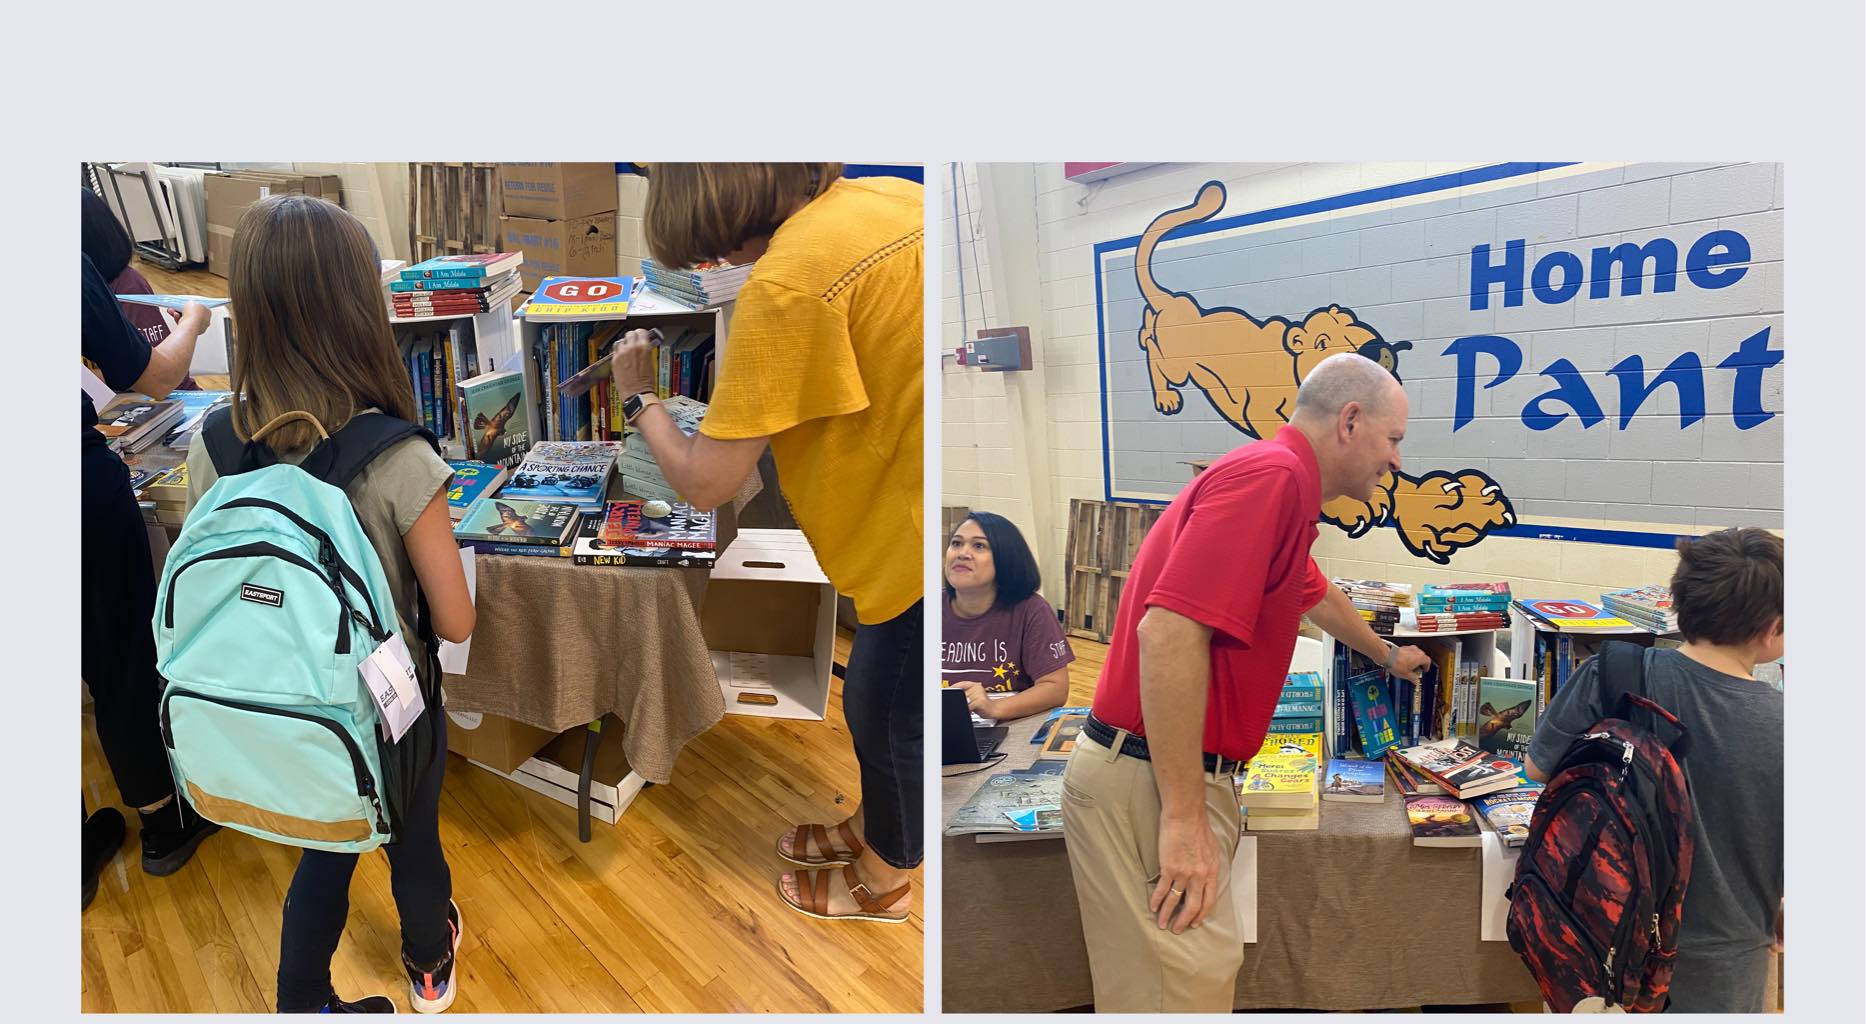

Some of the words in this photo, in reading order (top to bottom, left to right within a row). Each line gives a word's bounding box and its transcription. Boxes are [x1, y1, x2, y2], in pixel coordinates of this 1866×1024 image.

[1470, 230, 1751, 311] Home
[559, 285, 608, 297] GO
[1442, 326, 1784, 433] Pant
[513, 431, 527, 444] SIDE
[527, 462, 570, 473] SPORTING
[570, 463, 607, 473] CHANCE
[594, 556, 611, 565] NEW
[613, 555, 626, 565] KID
[244, 589, 279, 601] EASTSPORT
[994, 639, 1007, 662] IS
